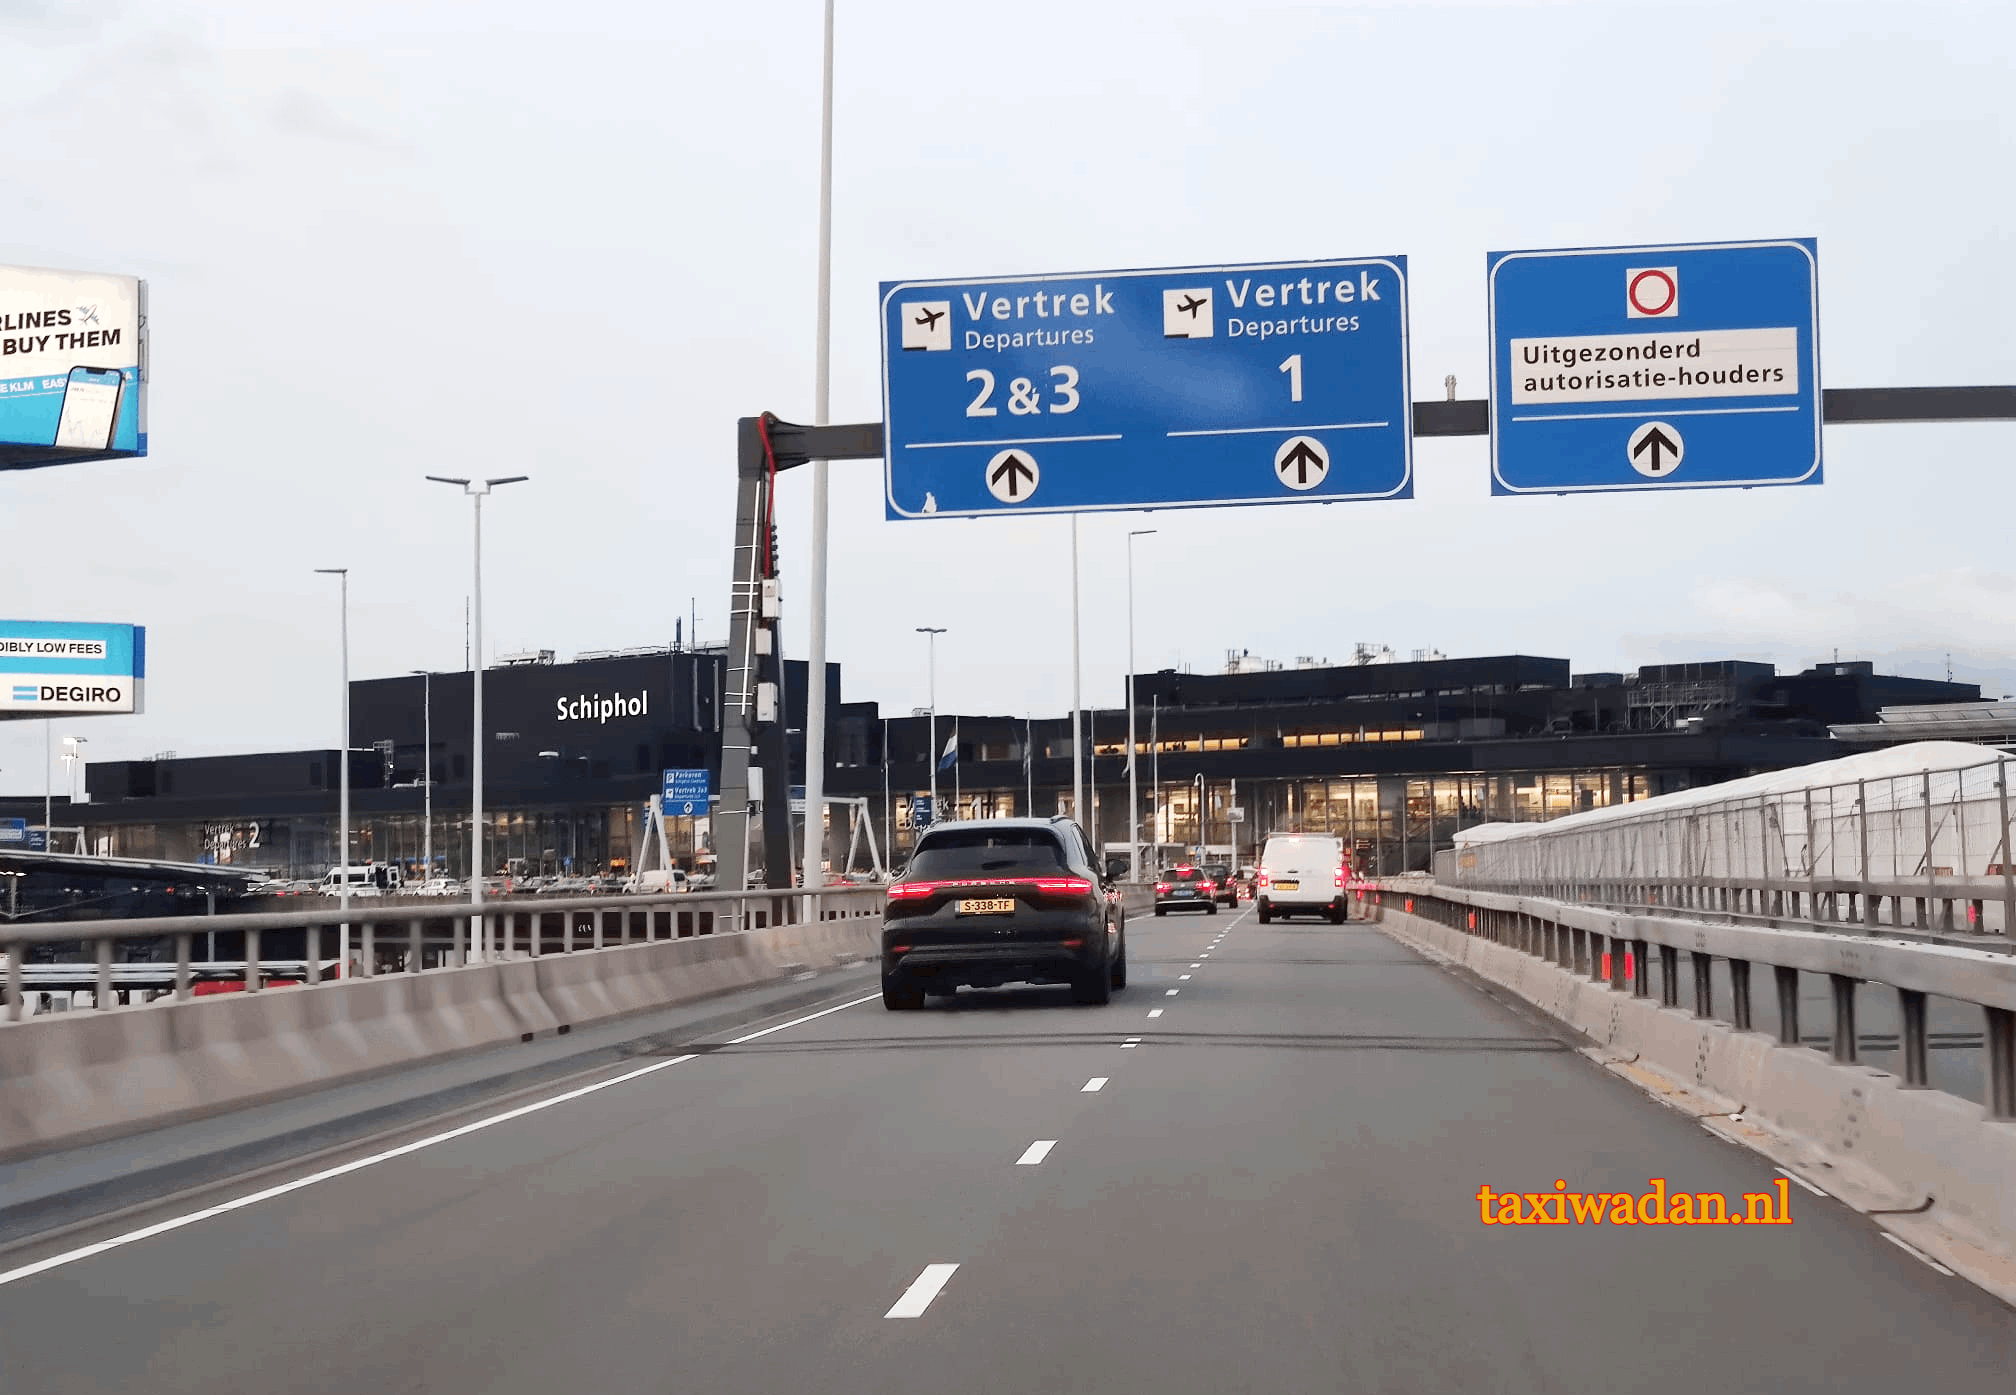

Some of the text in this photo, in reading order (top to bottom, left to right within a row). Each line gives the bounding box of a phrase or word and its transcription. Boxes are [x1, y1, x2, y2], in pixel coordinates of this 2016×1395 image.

[962, 283, 1115, 321] Vertrek
[1225, 270, 1381, 308] Vertrek
[0, 309, 72, 332] LINES
[1228, 314, 1360, 341] Departures
[3, 328, 121, 356] BUY THEM
[965, 328, 1094, 353] Departures
[1523, 338, 1701, 368] Uitgezonderd
[10, 381, 34, 392] KLM
[1278, 354, 1303, 402] 1
[1524, 364, 1784, 392] autorisatie-houders
[37, 642, 66, 653] LOW
[69, 643, 103, 654] FEES
[41, 686, 121, 702] DEGIRO
[557, 690, 648, 724] Schiphol
[205, 823, 234, 835] Vertrek
[249, 821, 260, 848] 2
[964, 900, 1011, 911] S-338-TF
